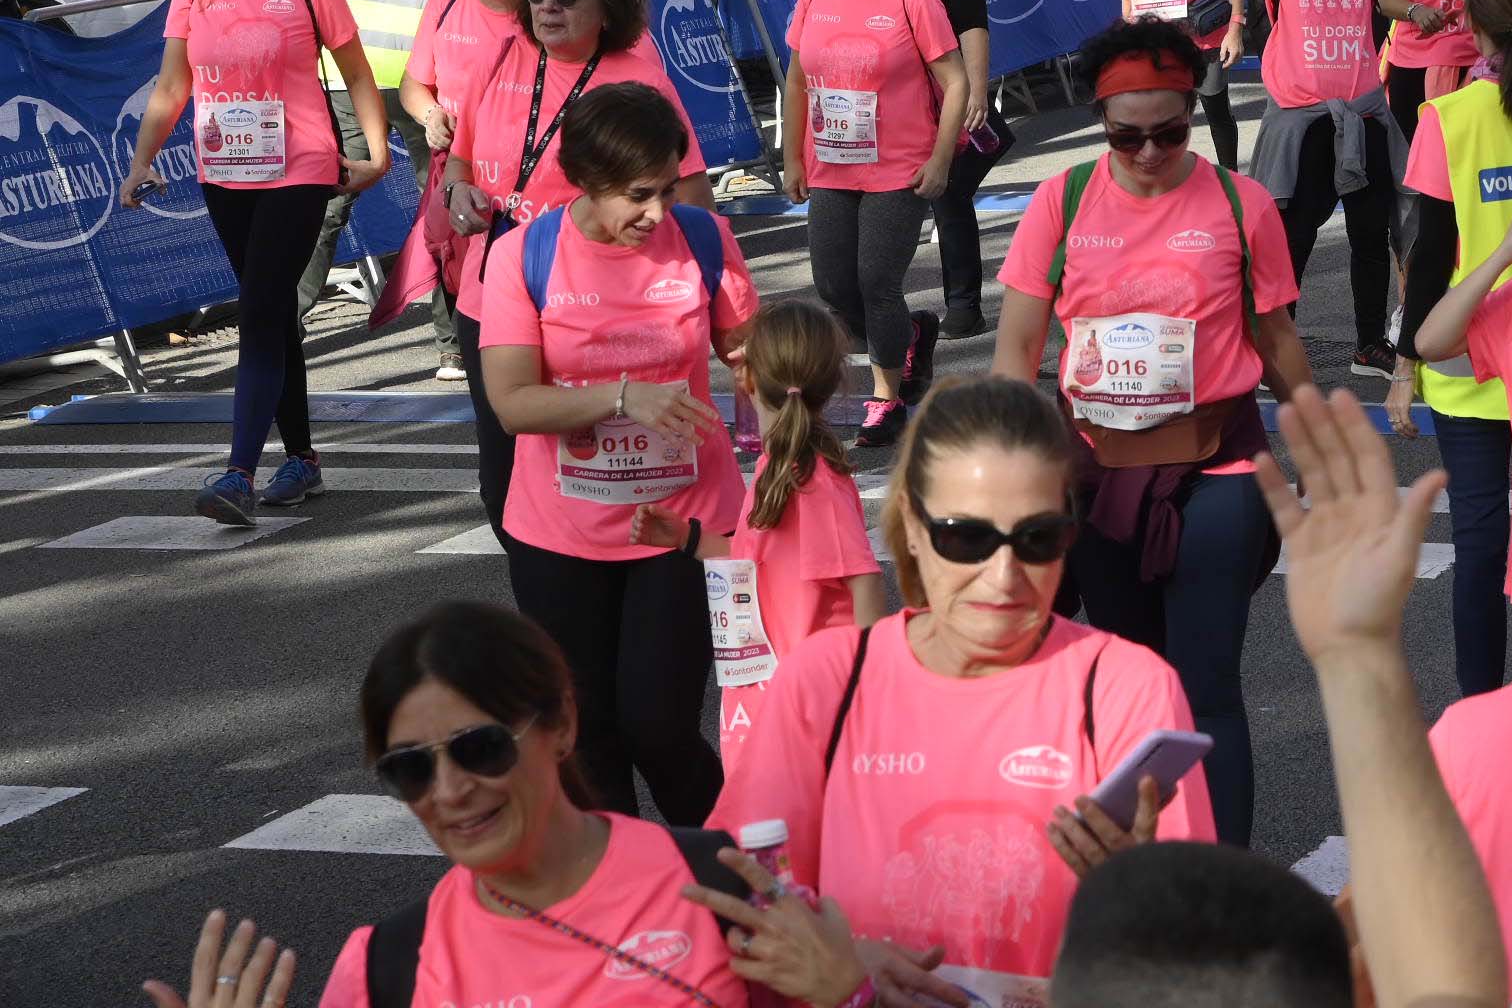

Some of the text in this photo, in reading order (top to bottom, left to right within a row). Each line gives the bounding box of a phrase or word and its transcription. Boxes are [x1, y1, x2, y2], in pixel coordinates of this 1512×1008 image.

[1302, 26, 1320, 37] TU
[196, 65, 220, 83] TU
[826, 118, 848, 130] 016
[225, 133, 254, 145] 016
[828, 132, 845, 140] 21297
[228, 148, 250, 156] 21301
[477, 160, 499, 184] TU
[1069, 234, 1124, 249] OYSHO
[1106, 334, 1151, 344] ASTURIANA
[1107, 359, 1148, 376] 016
[1111, 381, 1143, 391] 11140
[1080, 394, 1113, 403] CARRERA
[1125, 396, 1136, 404] LA
[1136, 396, 1160, 404] MUJER
[1080, 406, 1115, 420] OYSHO
[602, 435, 649, 452] 016
[607, 456, 644, 468] 11144
[574, 469, 609, 479] CARRERA
[635, 470, 663, 478] MUJER
[572, 482, 611, 496] OYSHO
[730, 662, 769, 676] Santander
